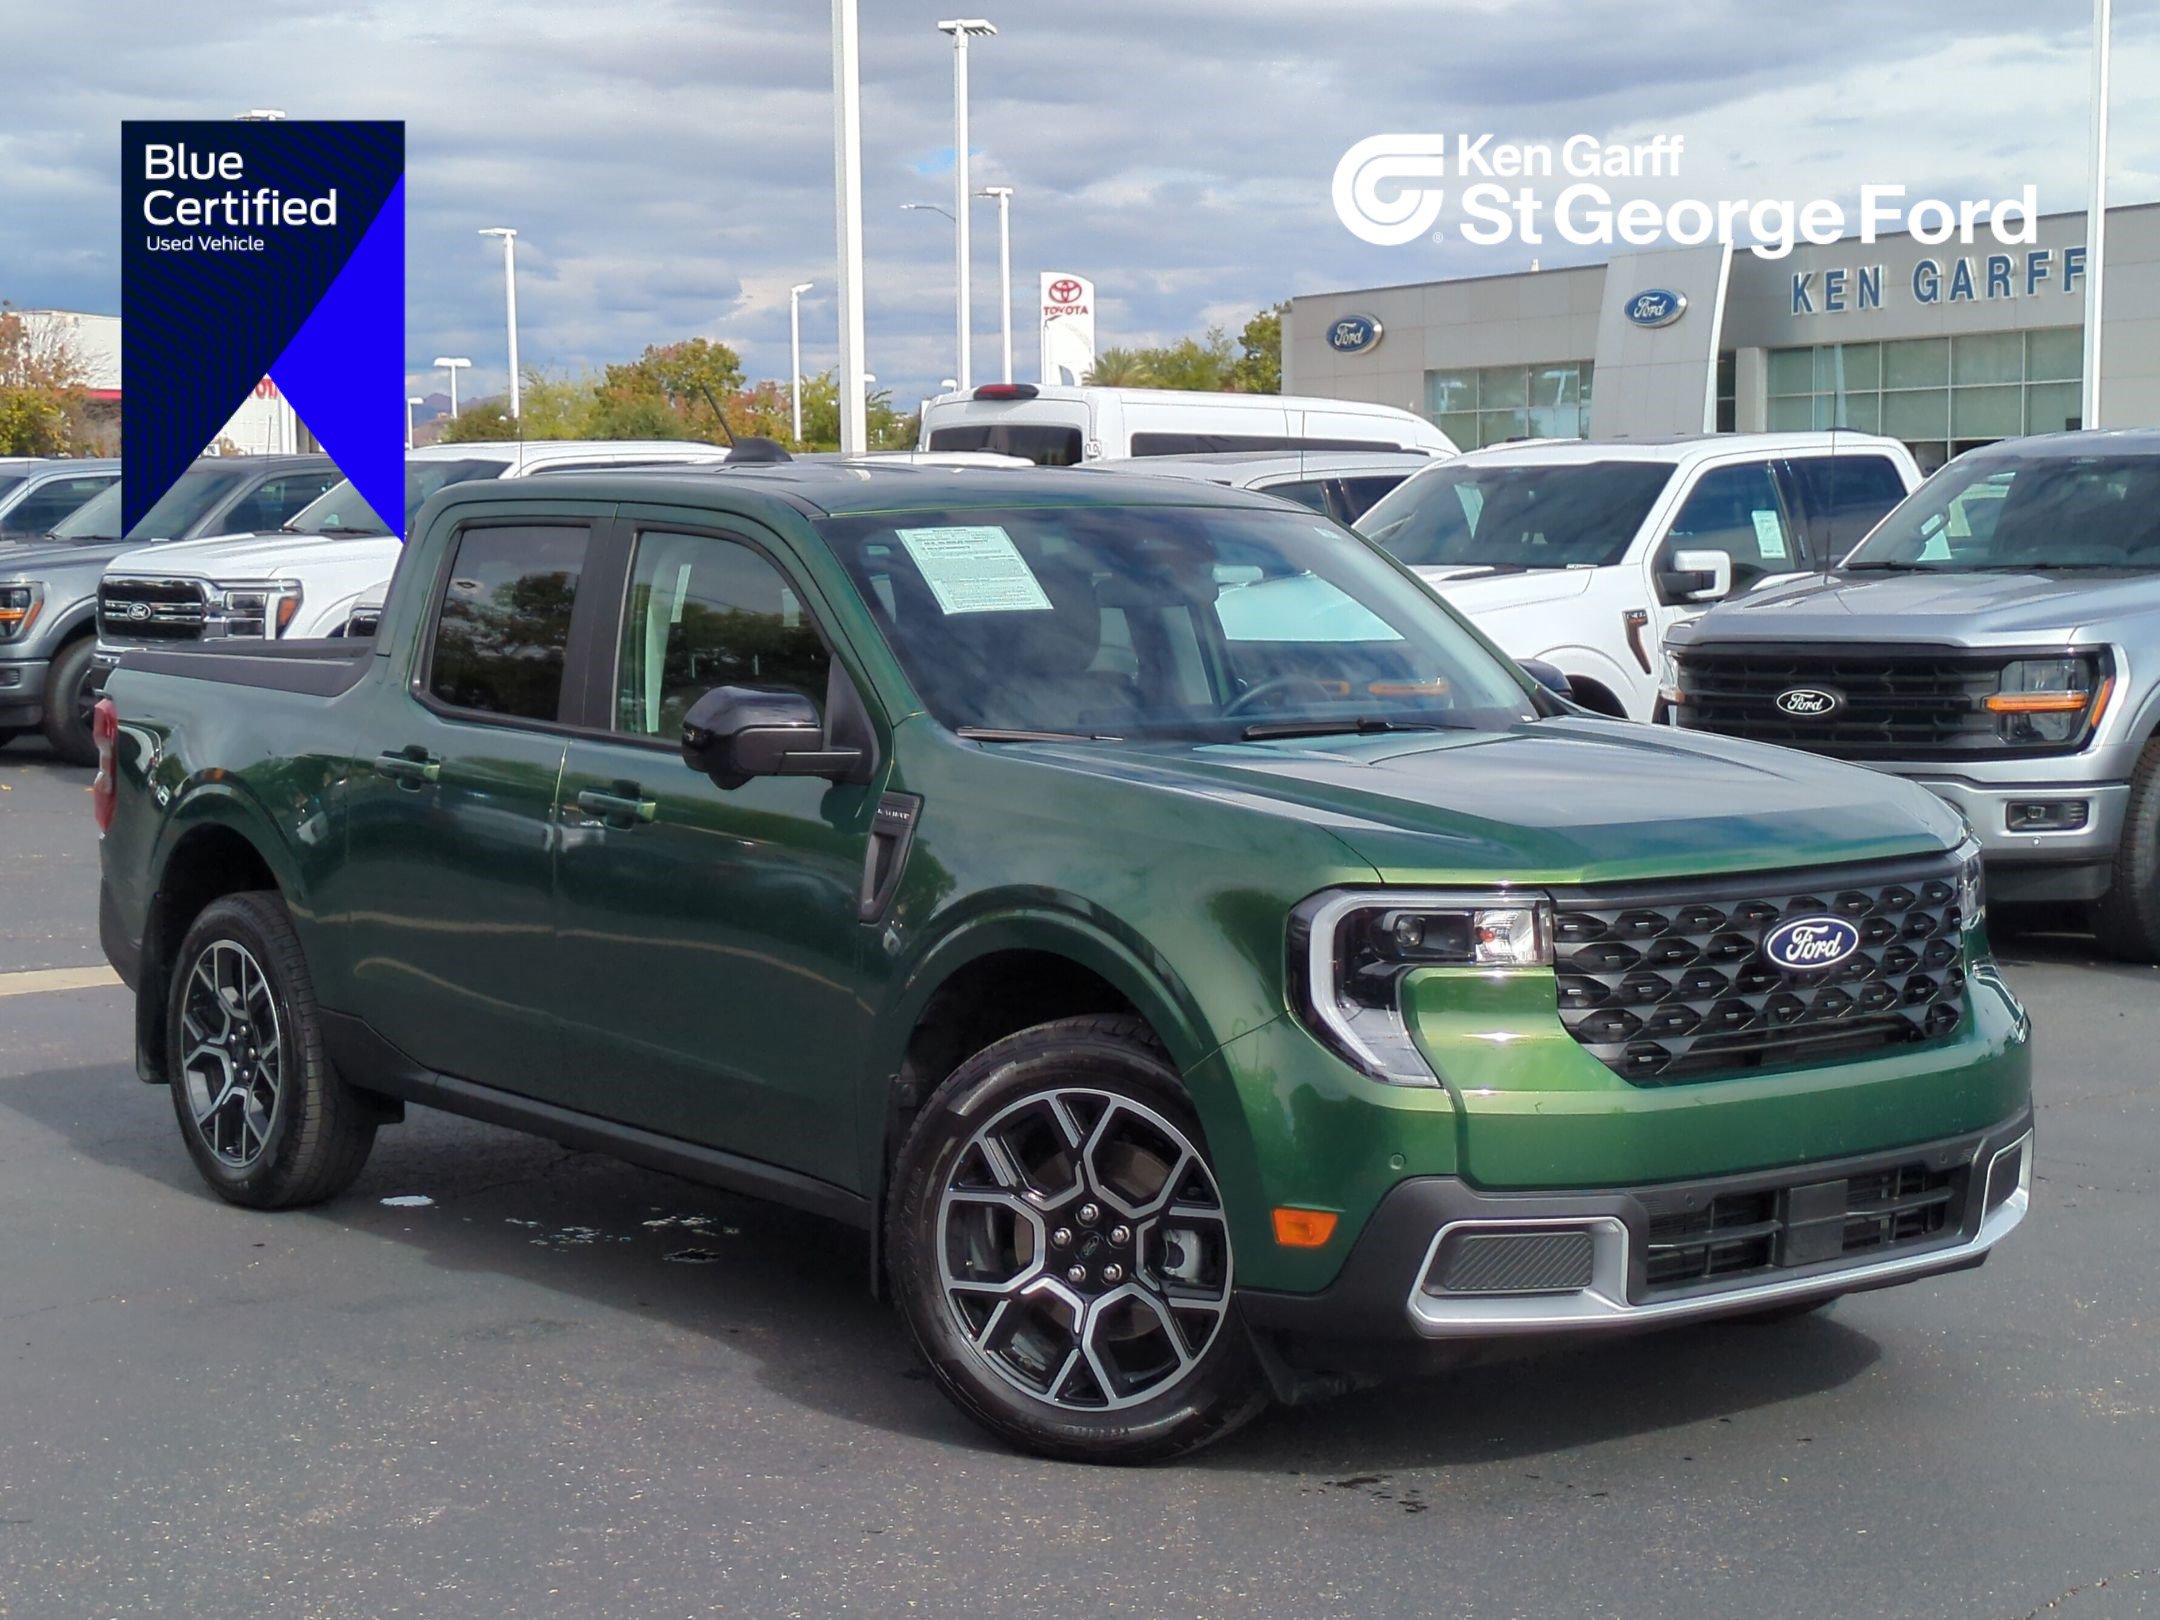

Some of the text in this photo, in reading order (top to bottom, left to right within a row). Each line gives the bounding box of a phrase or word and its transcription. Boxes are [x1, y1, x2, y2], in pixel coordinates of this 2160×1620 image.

[1791, 246, 2086, 316] KEN GARFF
[1043, 305, 1088, 316] TOYOTA
[1633, 295, 1667, 318] Ford
[1334, 322, 1364, 346] Ford
[1787, 693, 1824, 711] Ford
[1785, 925, 1843, 961] Ford
